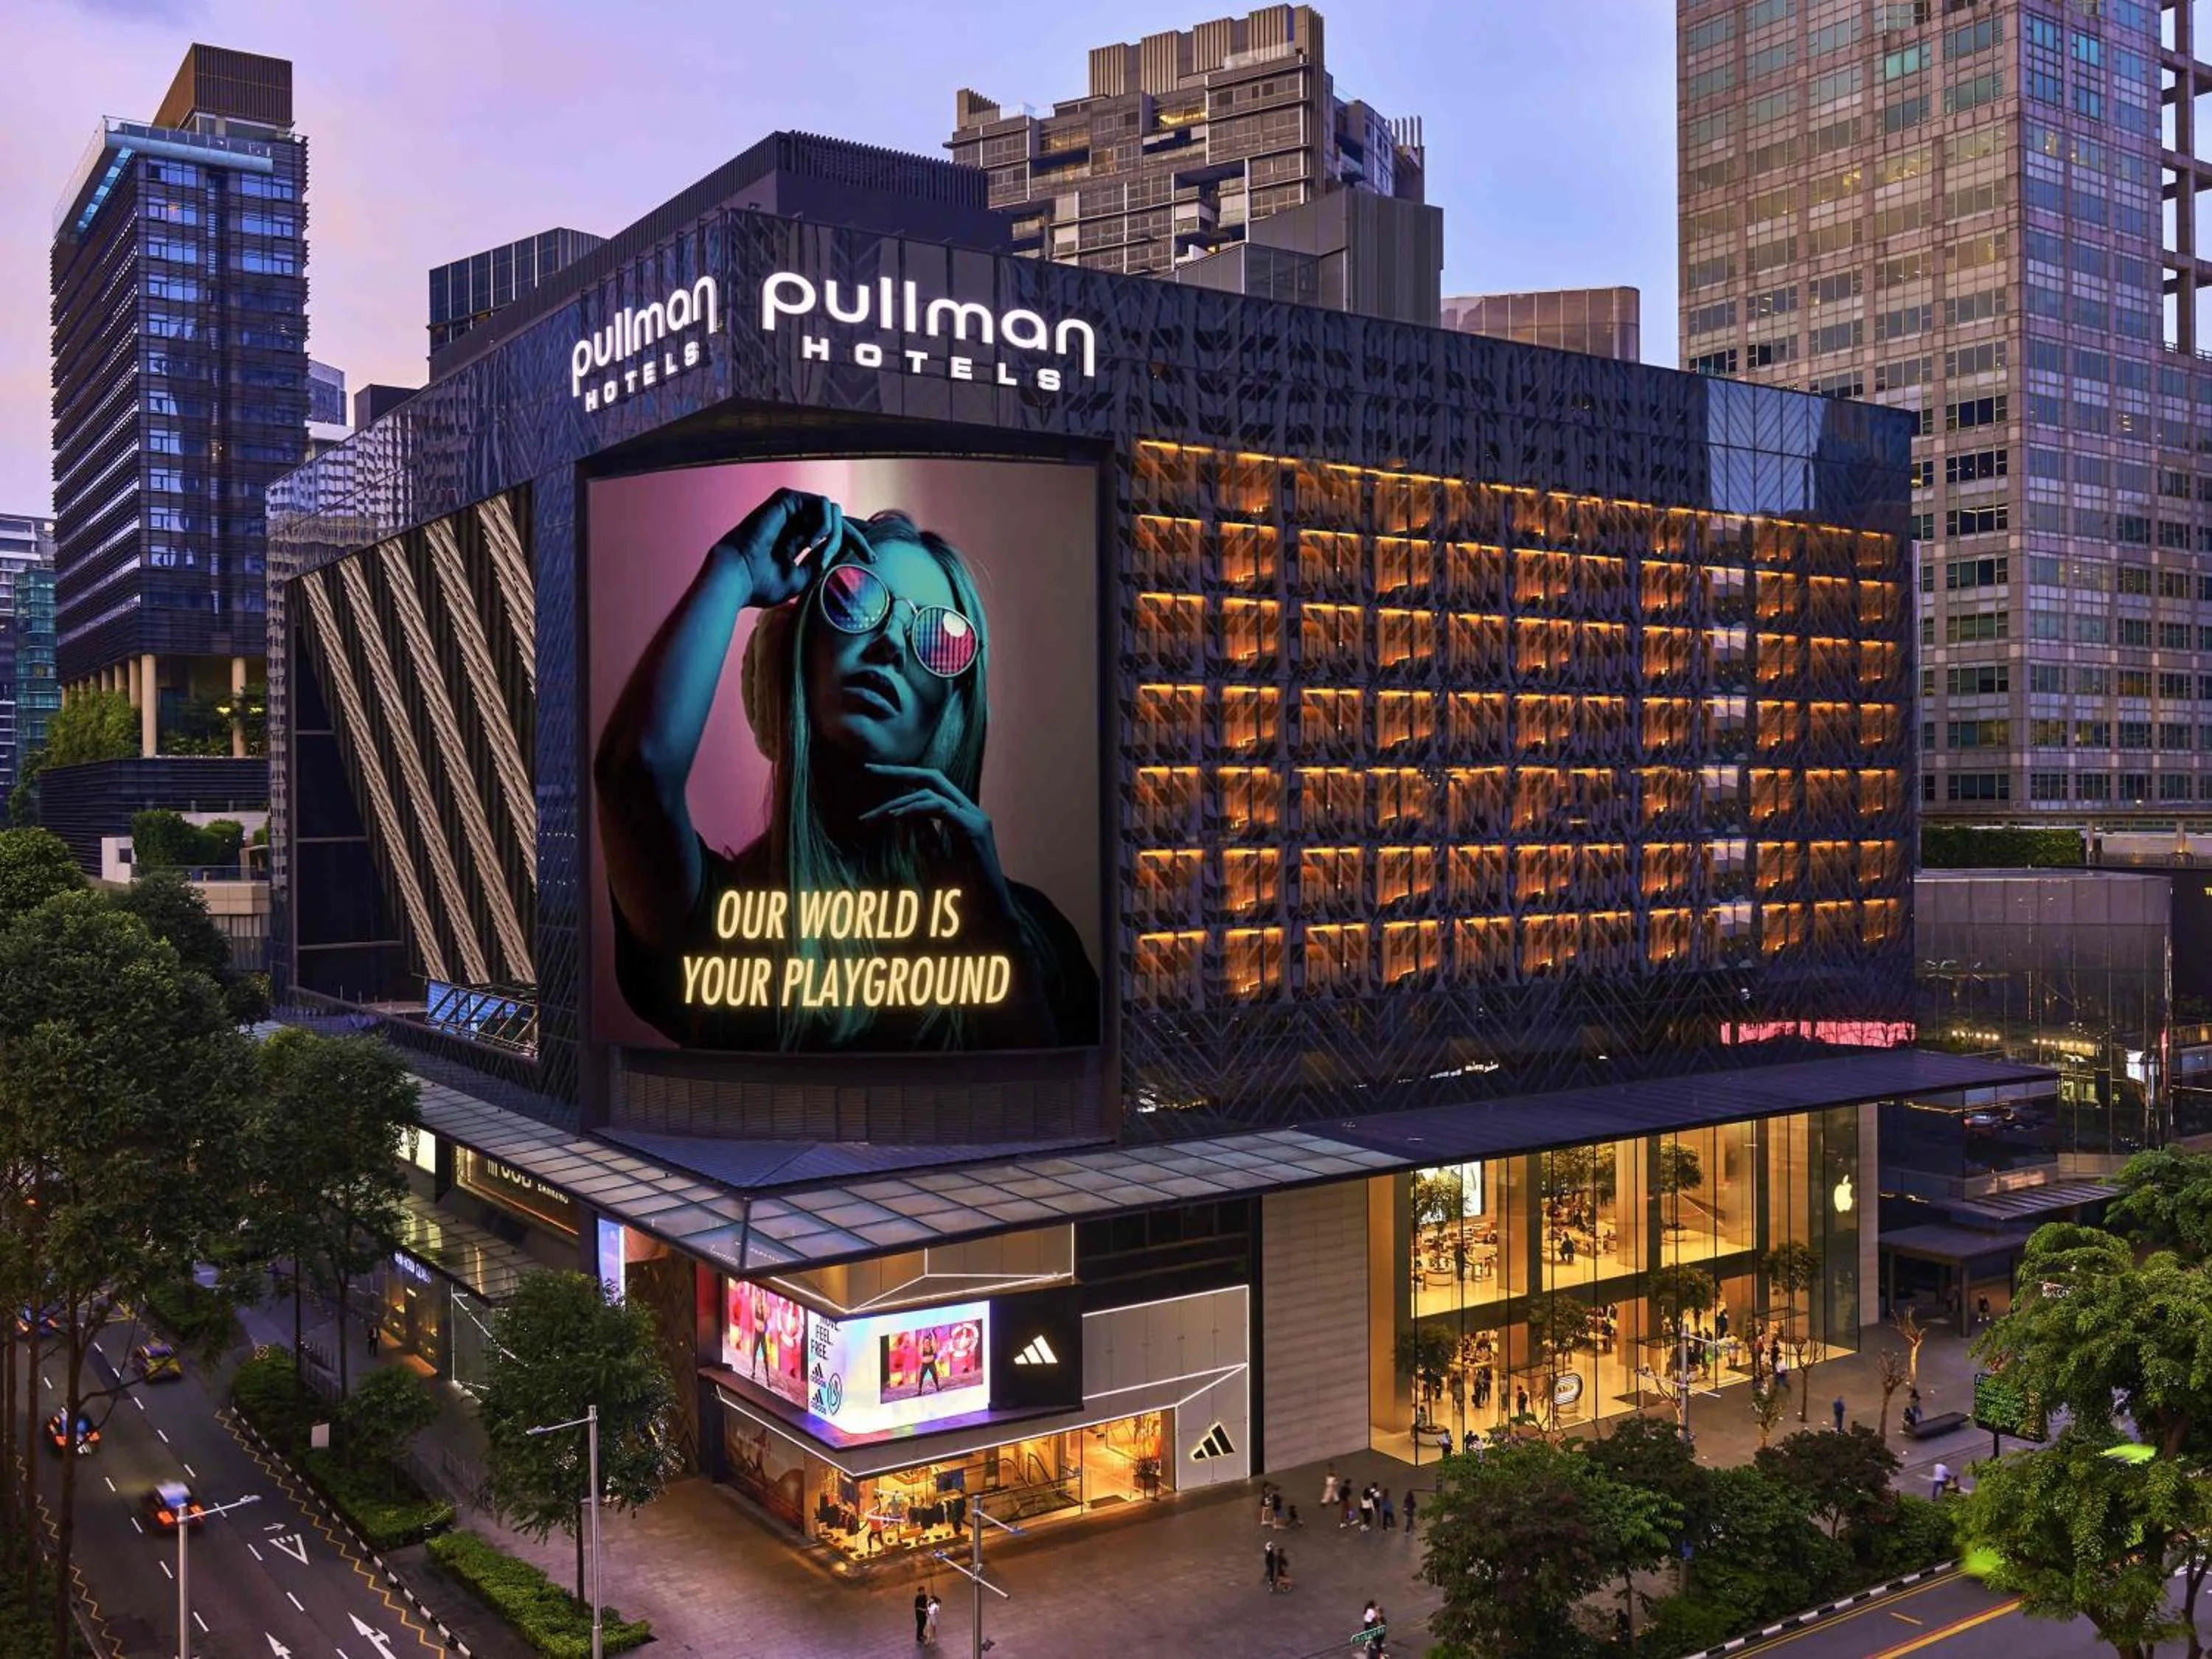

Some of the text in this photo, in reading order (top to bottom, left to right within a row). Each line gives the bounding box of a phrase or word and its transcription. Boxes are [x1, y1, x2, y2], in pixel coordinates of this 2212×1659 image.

[571, 275, 718, 398] pullman
[762, 271, 1096, 378] pullman
[585, 341, 700, 413] HOTELS
[802, 335, 1062, 392] HOTELS
[717, 888, 961, 939] OUR WORLD IS
[683, 955, 1011, 1007] YOUR PLAYGROUND
